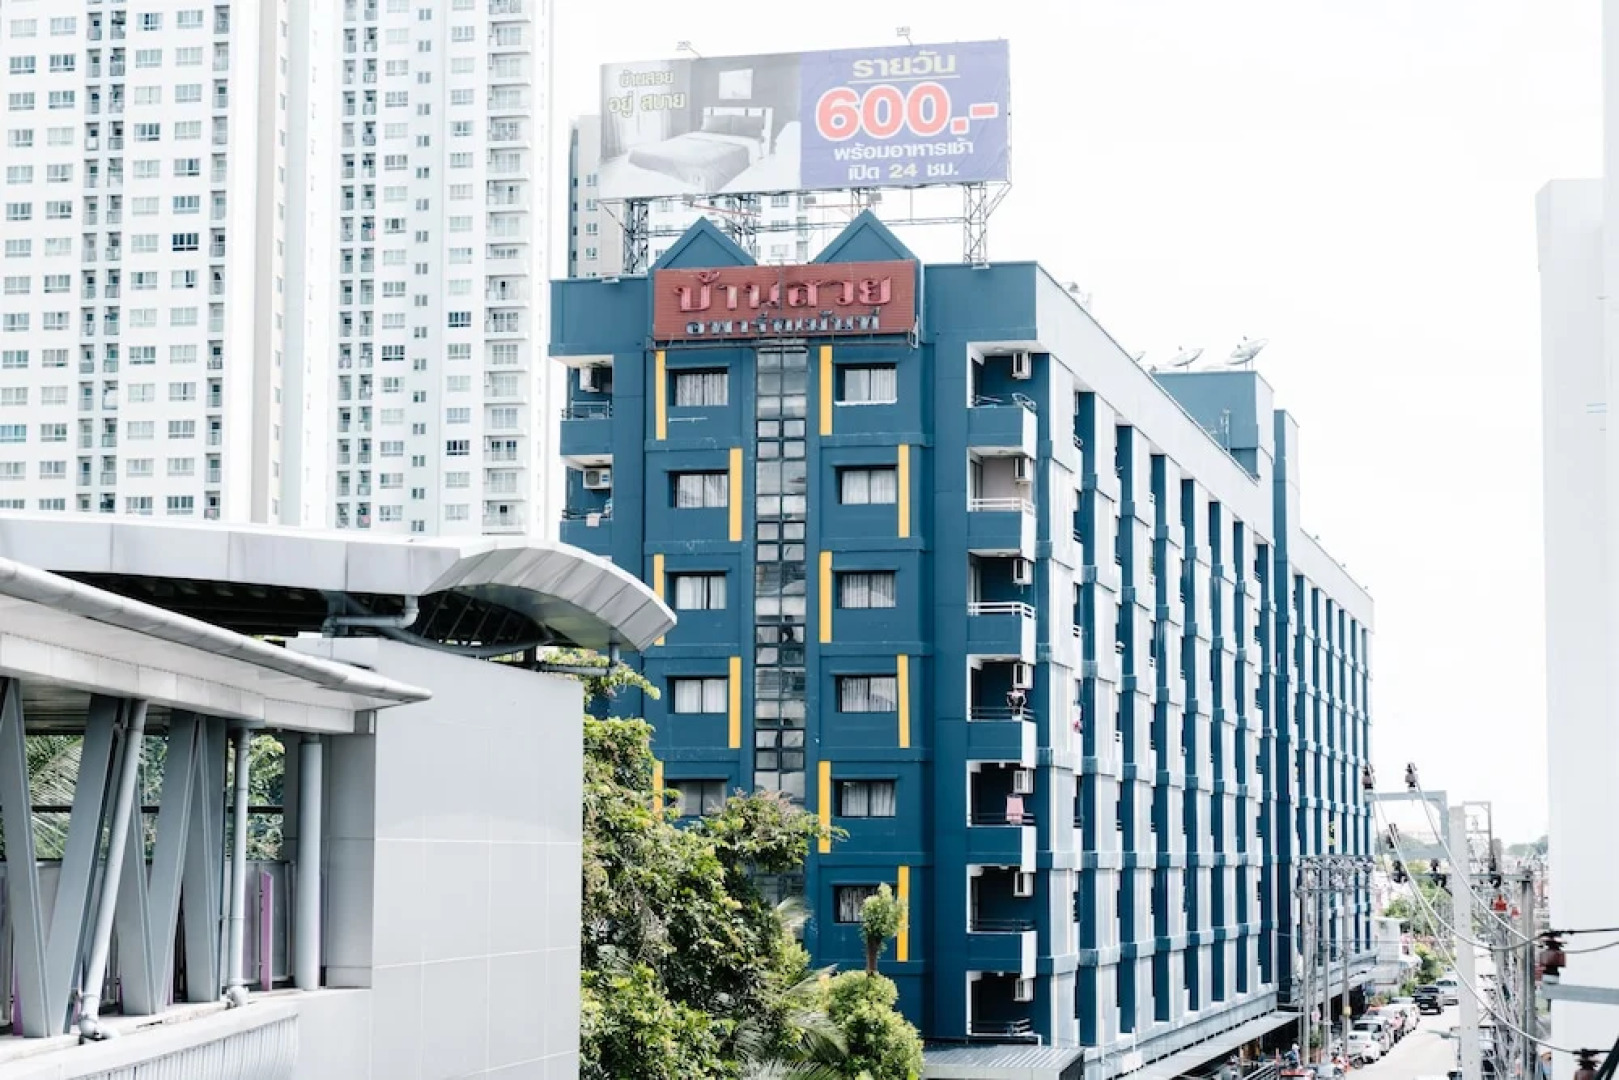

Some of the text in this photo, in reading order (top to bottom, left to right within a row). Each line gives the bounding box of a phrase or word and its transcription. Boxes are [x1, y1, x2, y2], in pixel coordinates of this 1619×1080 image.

[852, 50, 956, 77] รายวัน
[609, 90, 685, 118] อยู่ สบาย
[816, 81, 999, 141] 600.-
[834, 137, 974, 161] พร้อมอาหารเช้า
[848, 162, 959, 180] เปิด 24 ชม.
[673, 271, 892, 312] บ้านสวย
